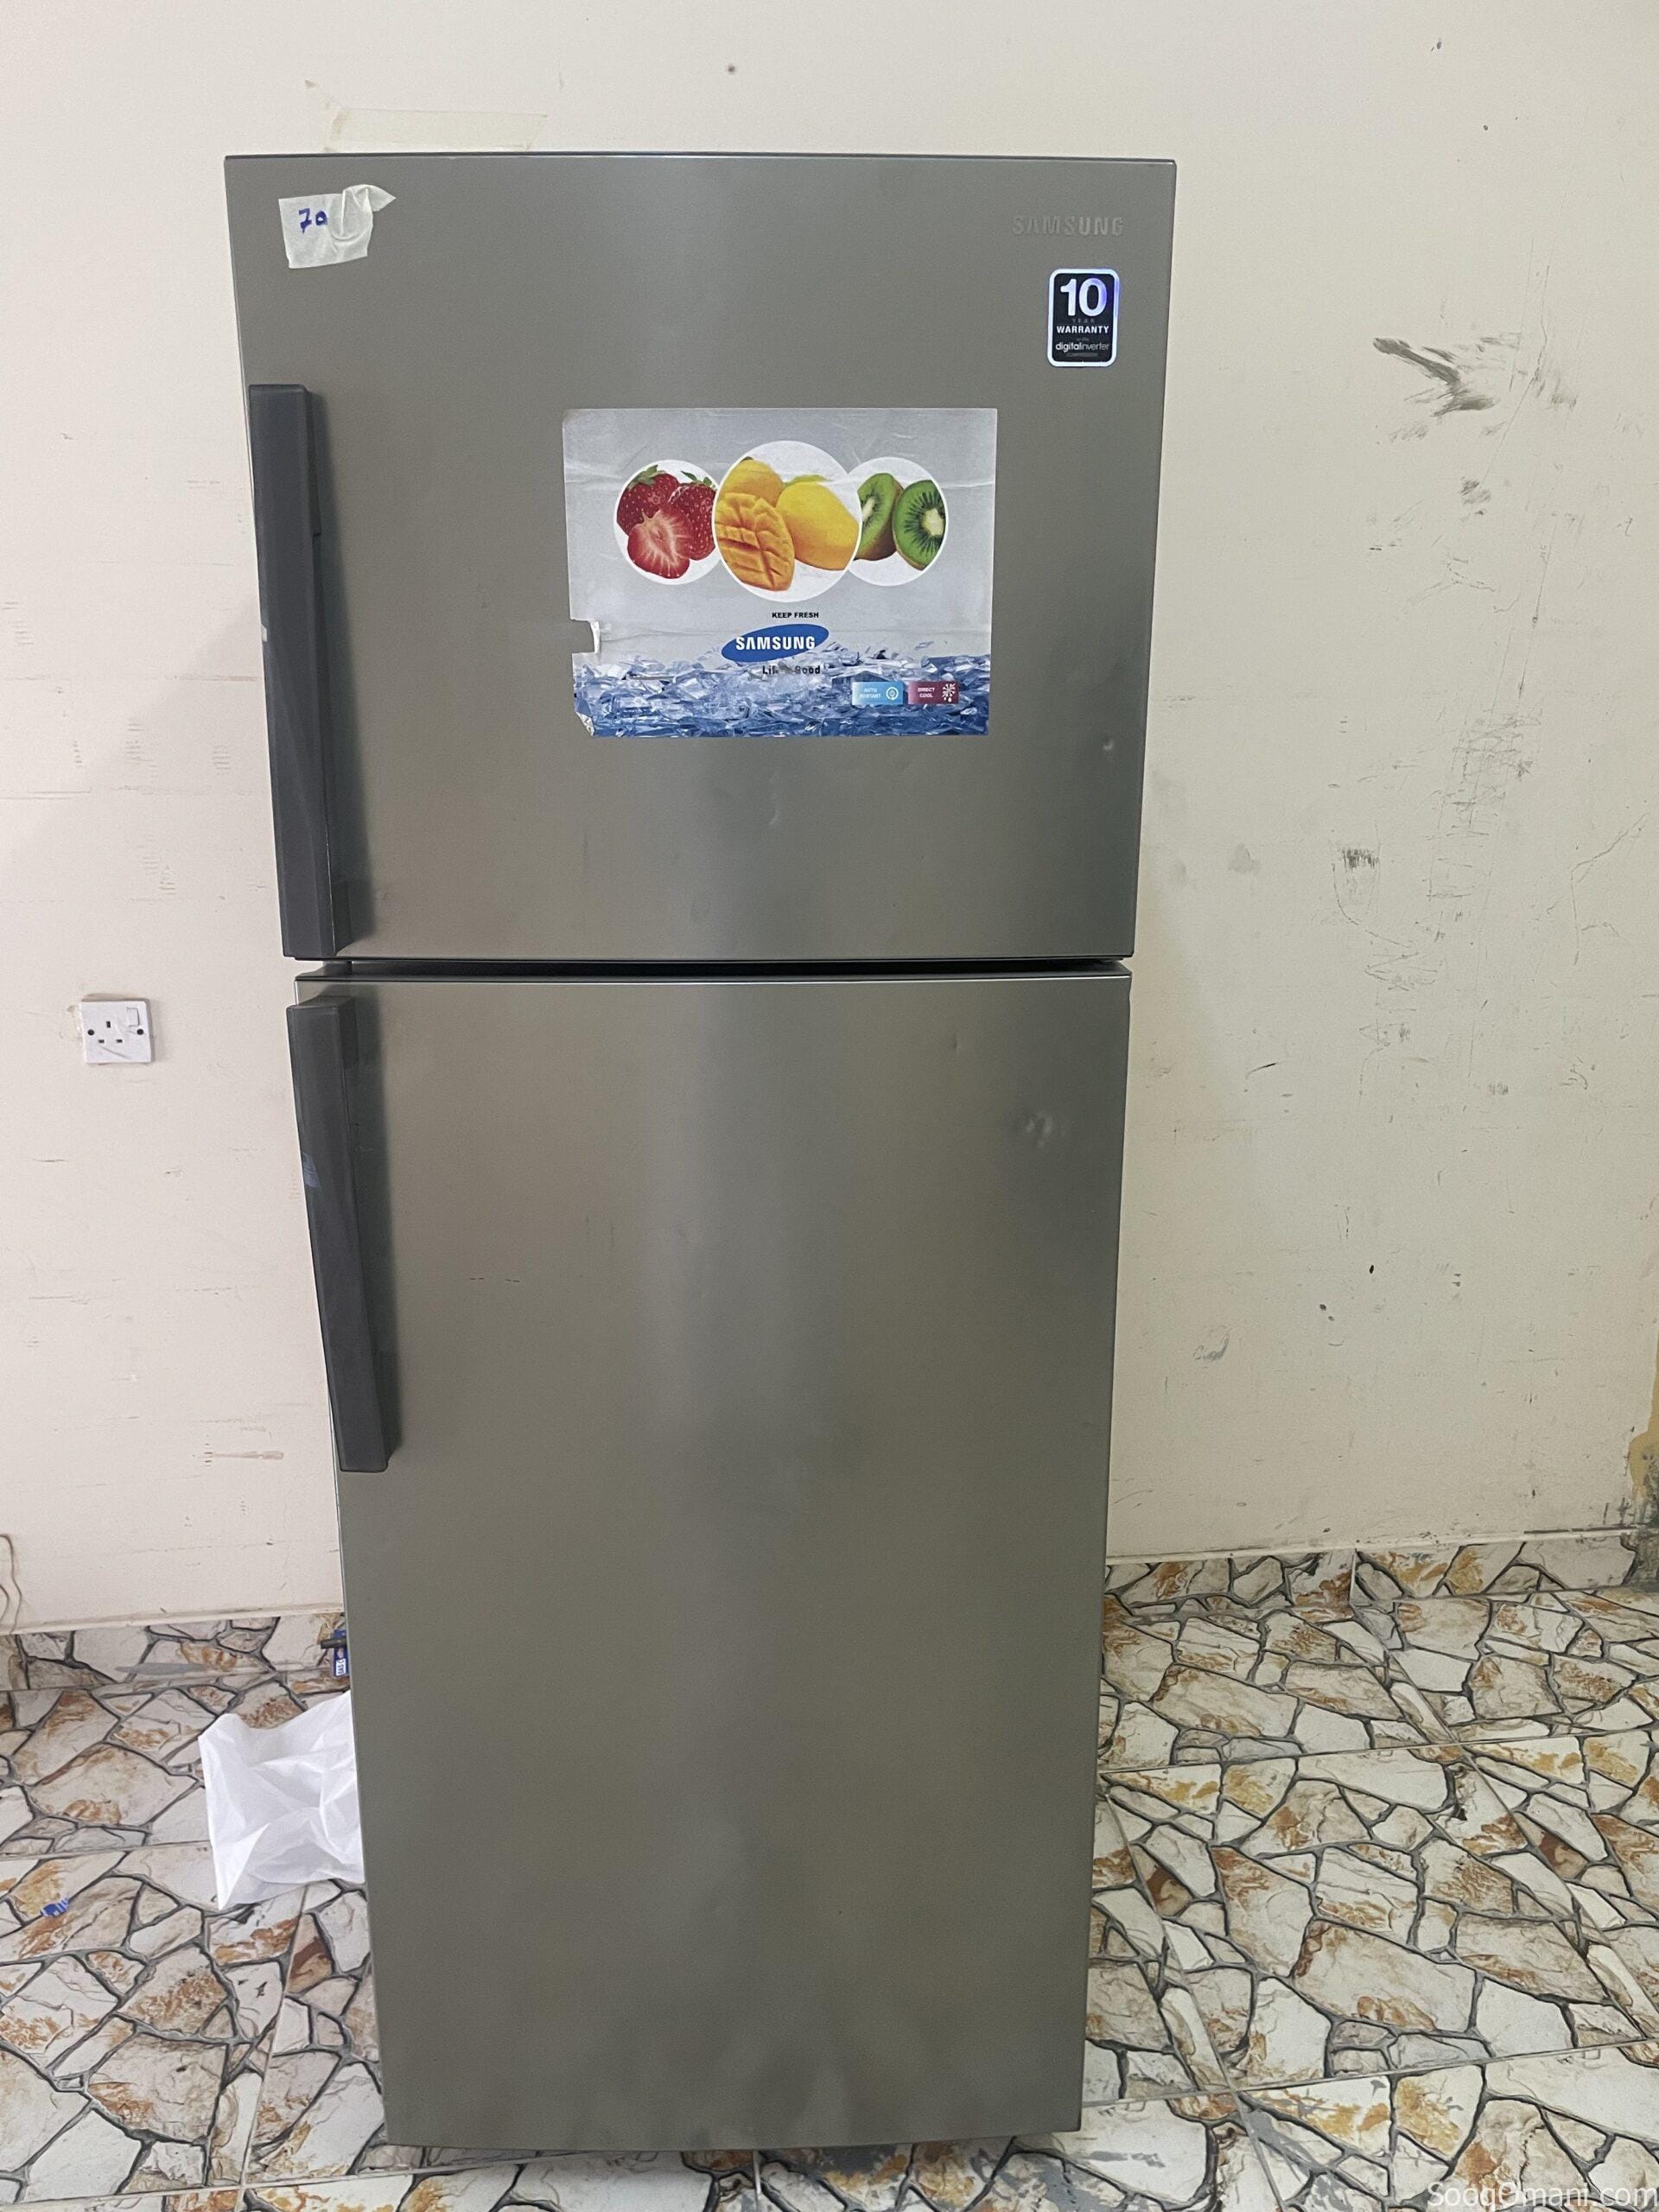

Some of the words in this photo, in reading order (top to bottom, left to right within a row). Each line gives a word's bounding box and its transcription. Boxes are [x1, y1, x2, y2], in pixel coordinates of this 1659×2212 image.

[1013, 216, 1124, 236] SAMSUNG
[1060, 277, 1108, 317] 10
[1056, 325, 1109, 334] WARRANTY
[735, 635, 816, 651] SAMSUNG
